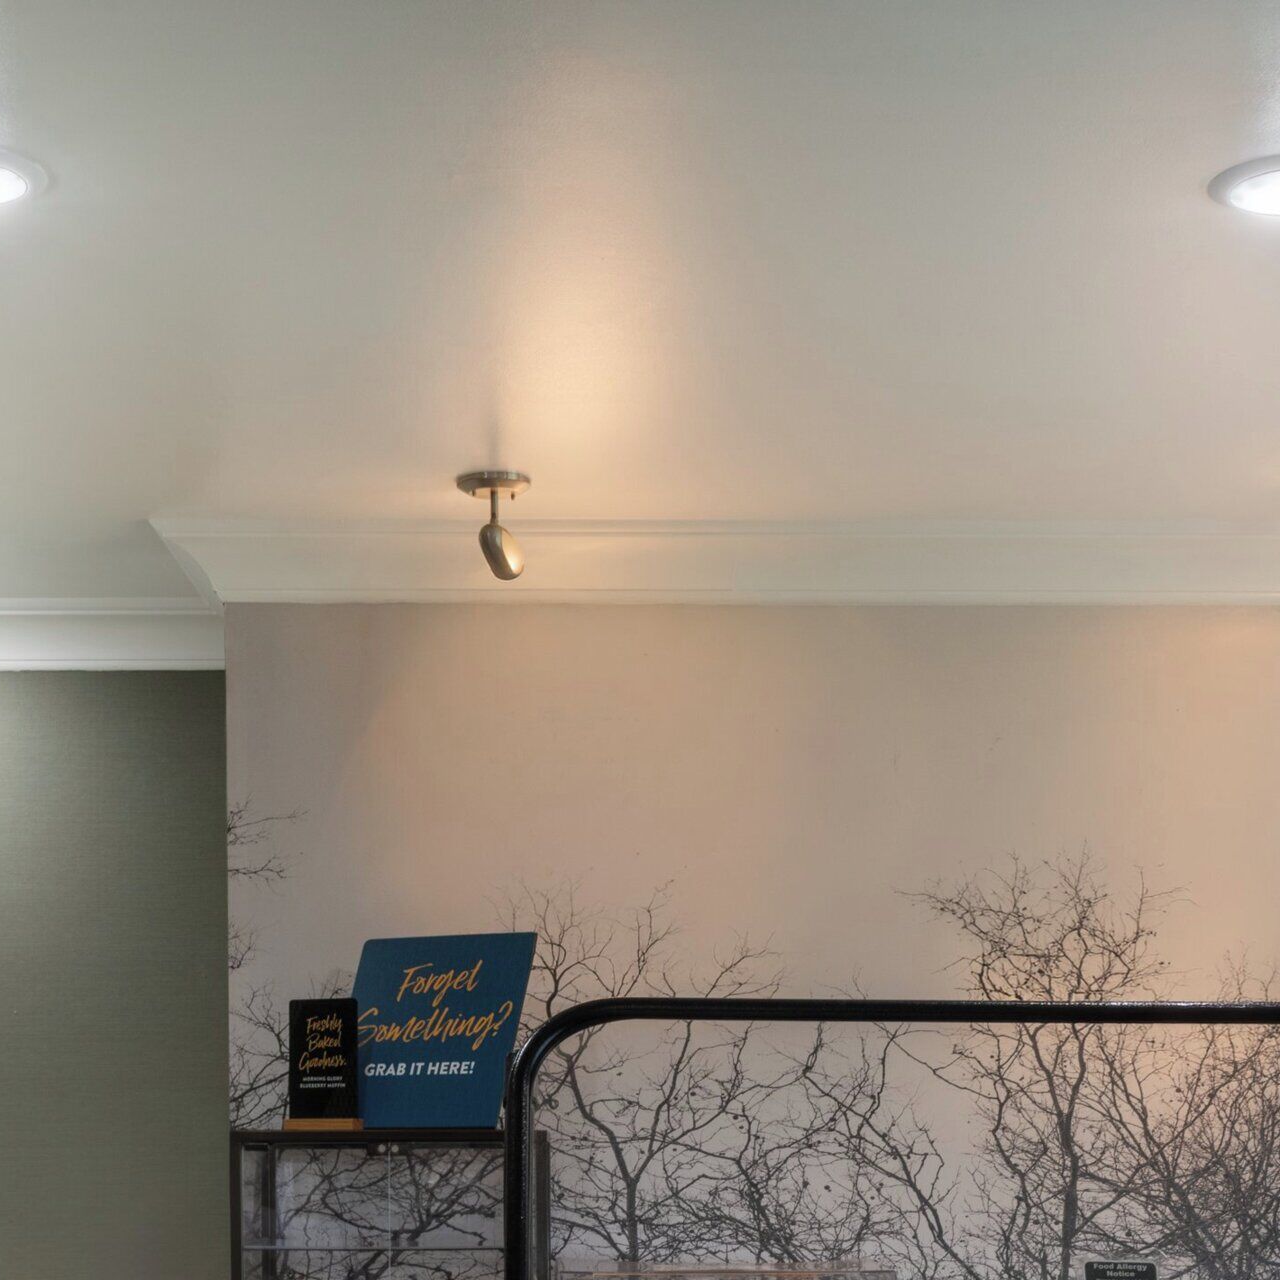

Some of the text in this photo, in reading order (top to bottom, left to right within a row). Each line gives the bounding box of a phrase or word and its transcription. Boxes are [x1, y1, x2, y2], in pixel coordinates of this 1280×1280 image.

[396, 959, 484, 1008] Forget
[306, 1013, 343, 1034] Freshly
[357, 1000, 514, 1051] Something?
[306, 1031, 342, 1052] Baked
[364, 1061, 476, 1077] GRAB IT HERE!
[1116, 1263, 1148, 1272] Allergy
